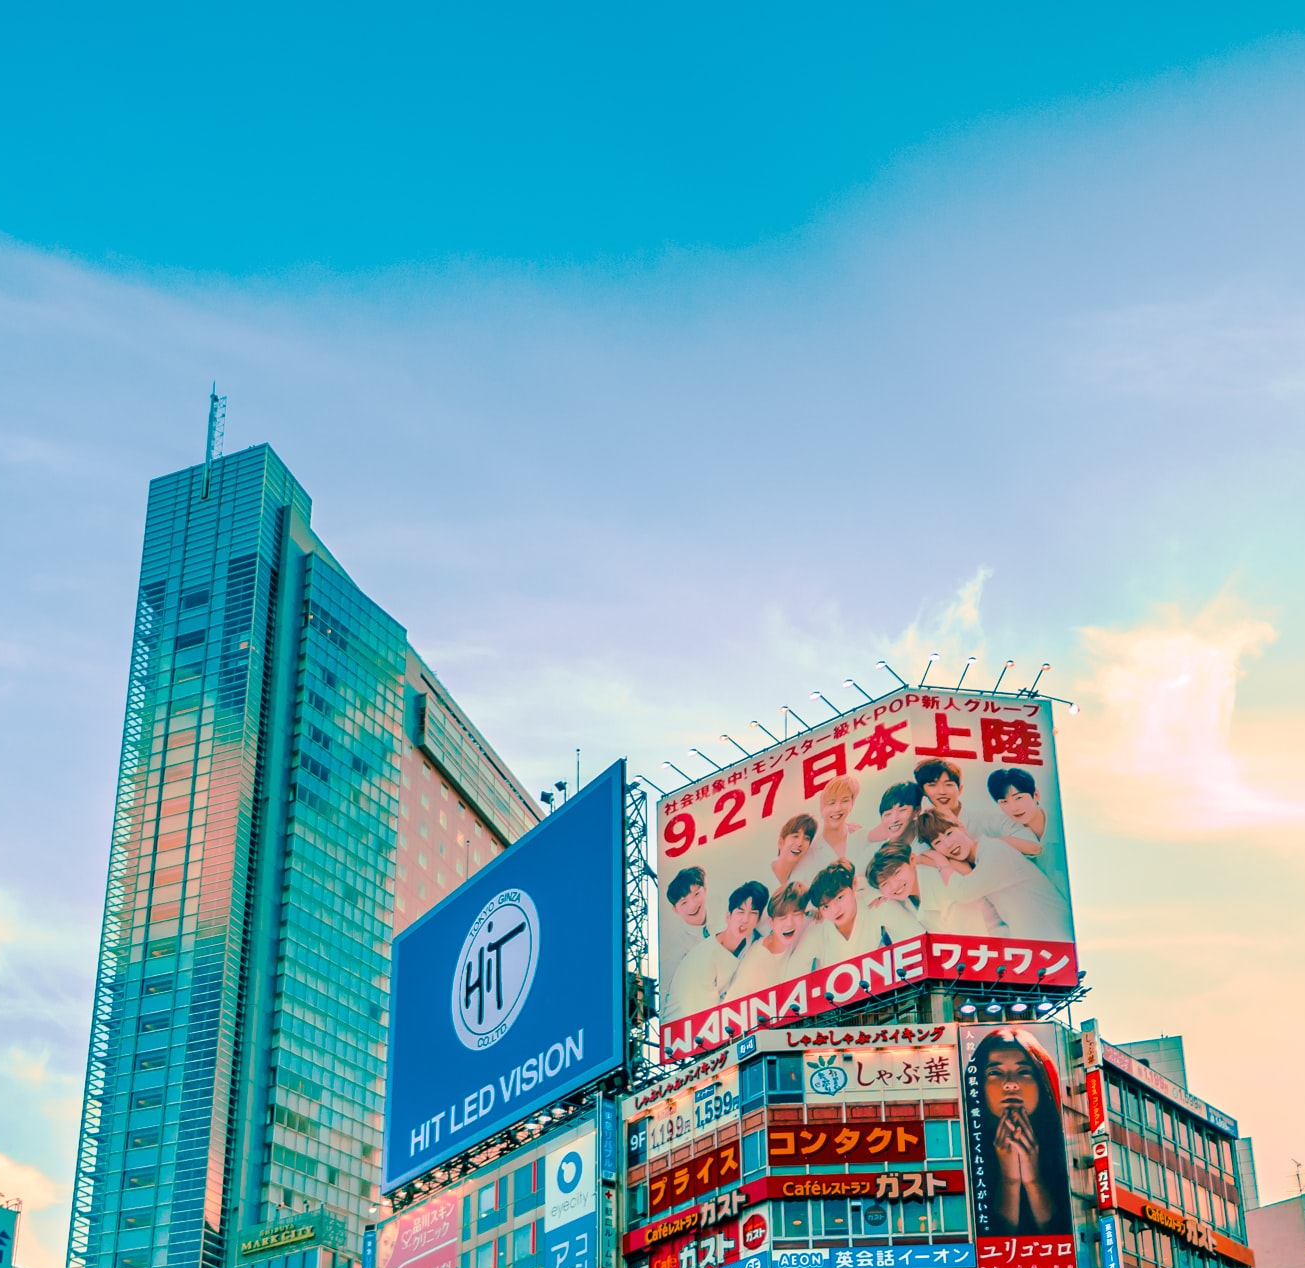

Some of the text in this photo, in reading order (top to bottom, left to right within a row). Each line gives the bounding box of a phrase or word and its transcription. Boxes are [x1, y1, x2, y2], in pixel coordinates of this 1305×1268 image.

[663, 713, 1044, 859] 9.27 日本上陸
[469, 891, 521, 938] TOKYO GINZA
[931, 942, 1070, 974] ワナワン
[787, 1026, 945, 1046] しゃぶしゃぶバイキング
[857, 1056, 950, 1086] しゃぶ葉
[410, 1028, 584, 1158] HIT LED VISION
[630, 1131, 646, 1151] 9F
[770, 1126, 918, 1155] コンタクト
[651, 1147, 739, 1206] プライス
[1098, 1170, 1110, 1203] ガスト
[551, 1192, 589, 1219] eyecity
[242, 1226, 315, 1251] MARK CITY
[746, 1228, 765, 1241] ガスト
[780, 1249, 968, 1268] AEON 英会話イーオン
[980, 1238, 1072, 1263] ユリゴコロ
